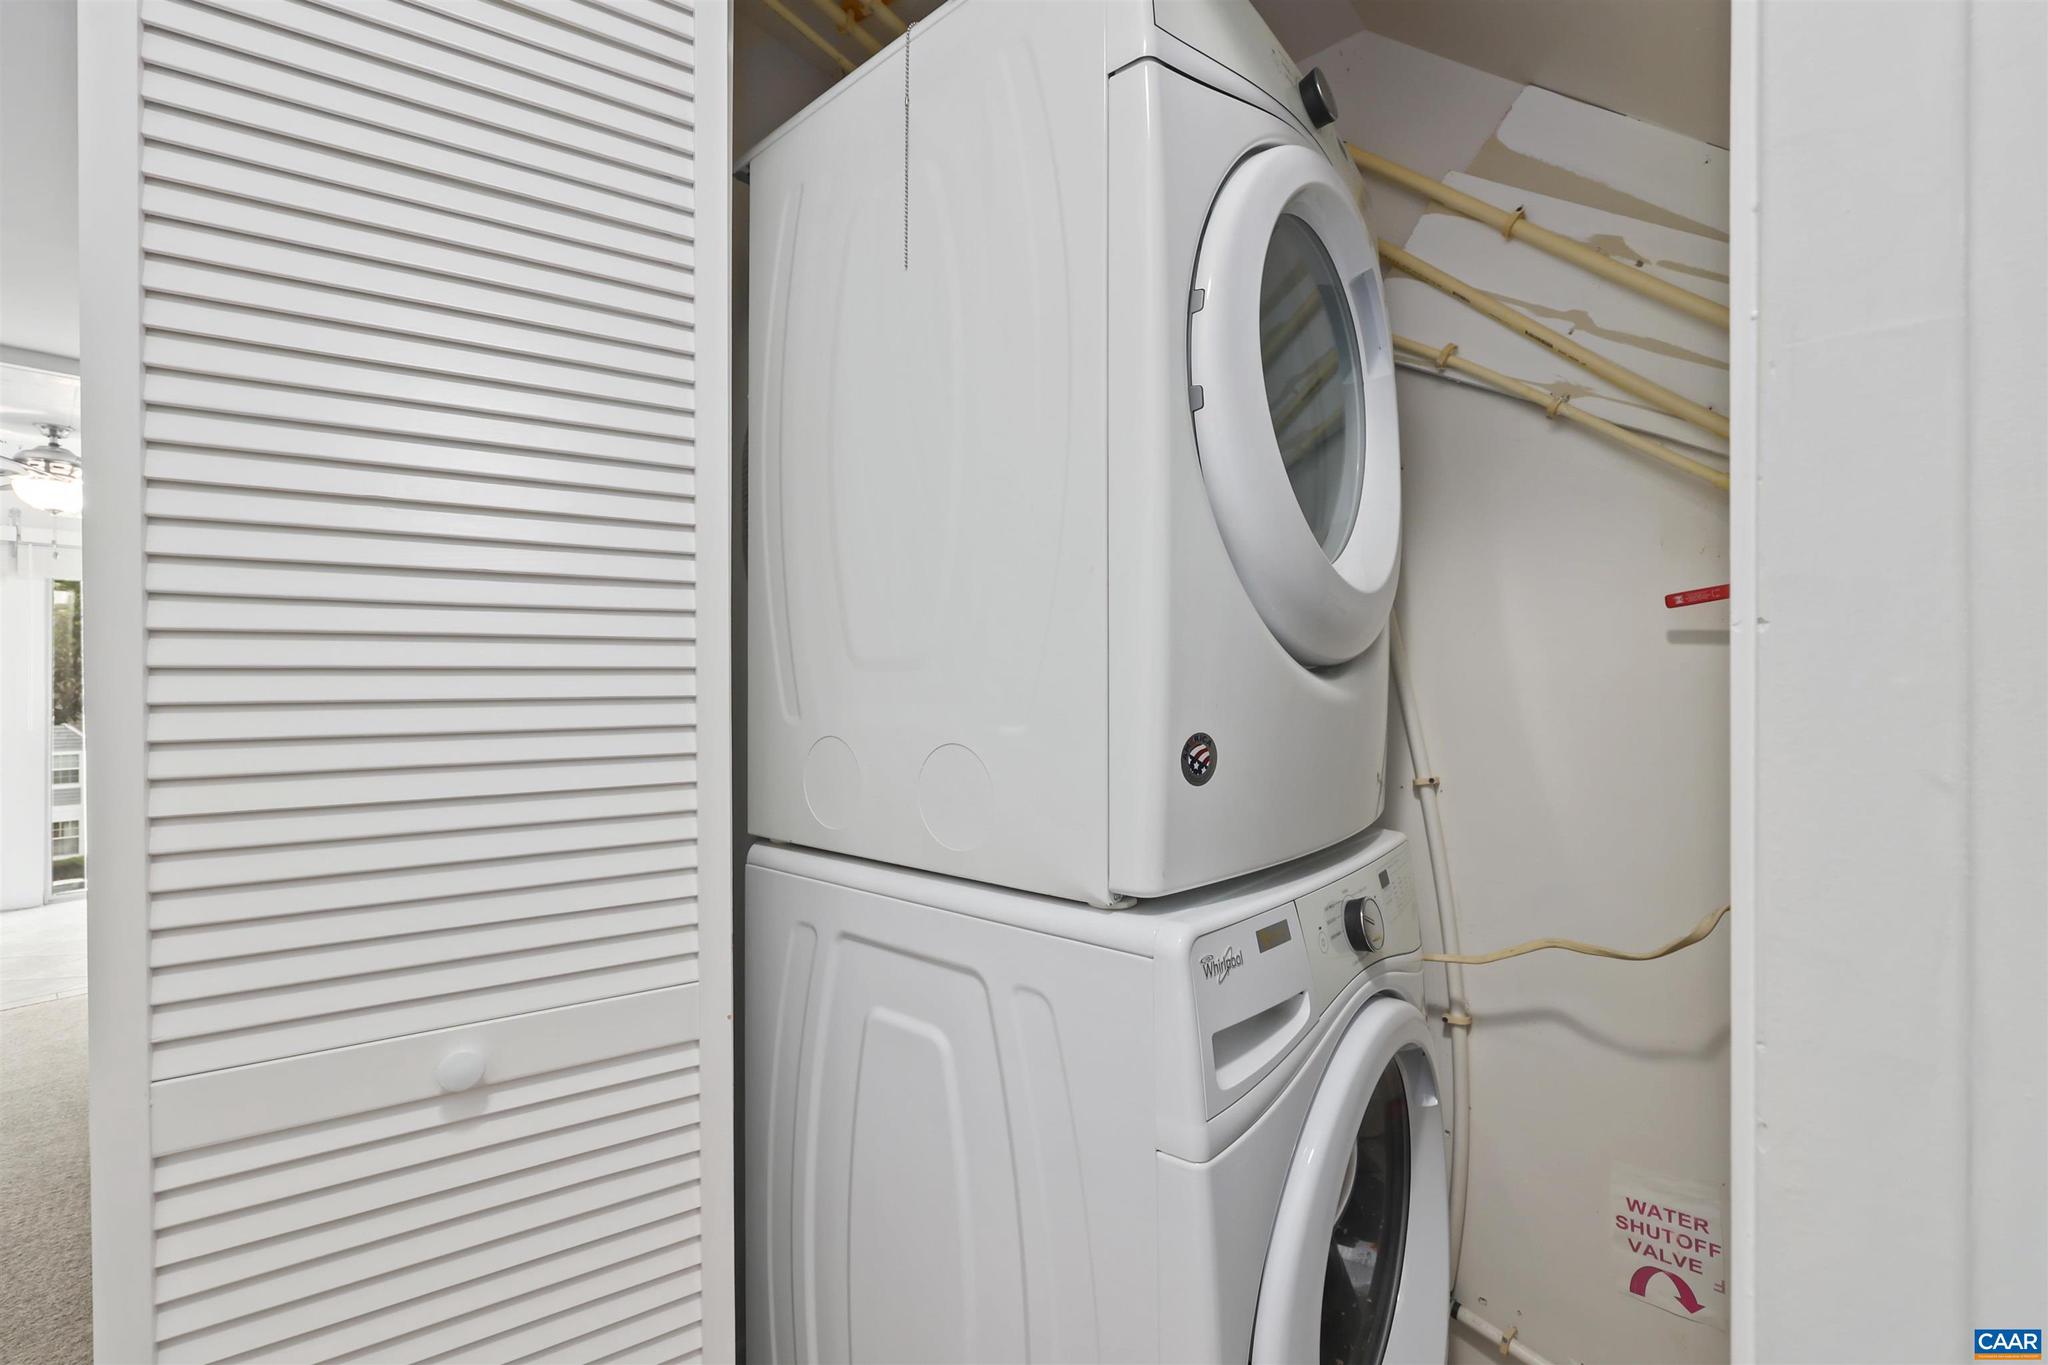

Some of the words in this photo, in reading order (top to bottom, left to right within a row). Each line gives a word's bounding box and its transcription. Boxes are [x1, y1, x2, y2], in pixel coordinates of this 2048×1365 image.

[1202, 947, 1243, 983] Whirlpool
[1625, 1197, 1709, 1234] WATER
[1616, 1215, 1722, 1258] SHUTOFF
[1628, 1238, 1703, 1275] VALVE
